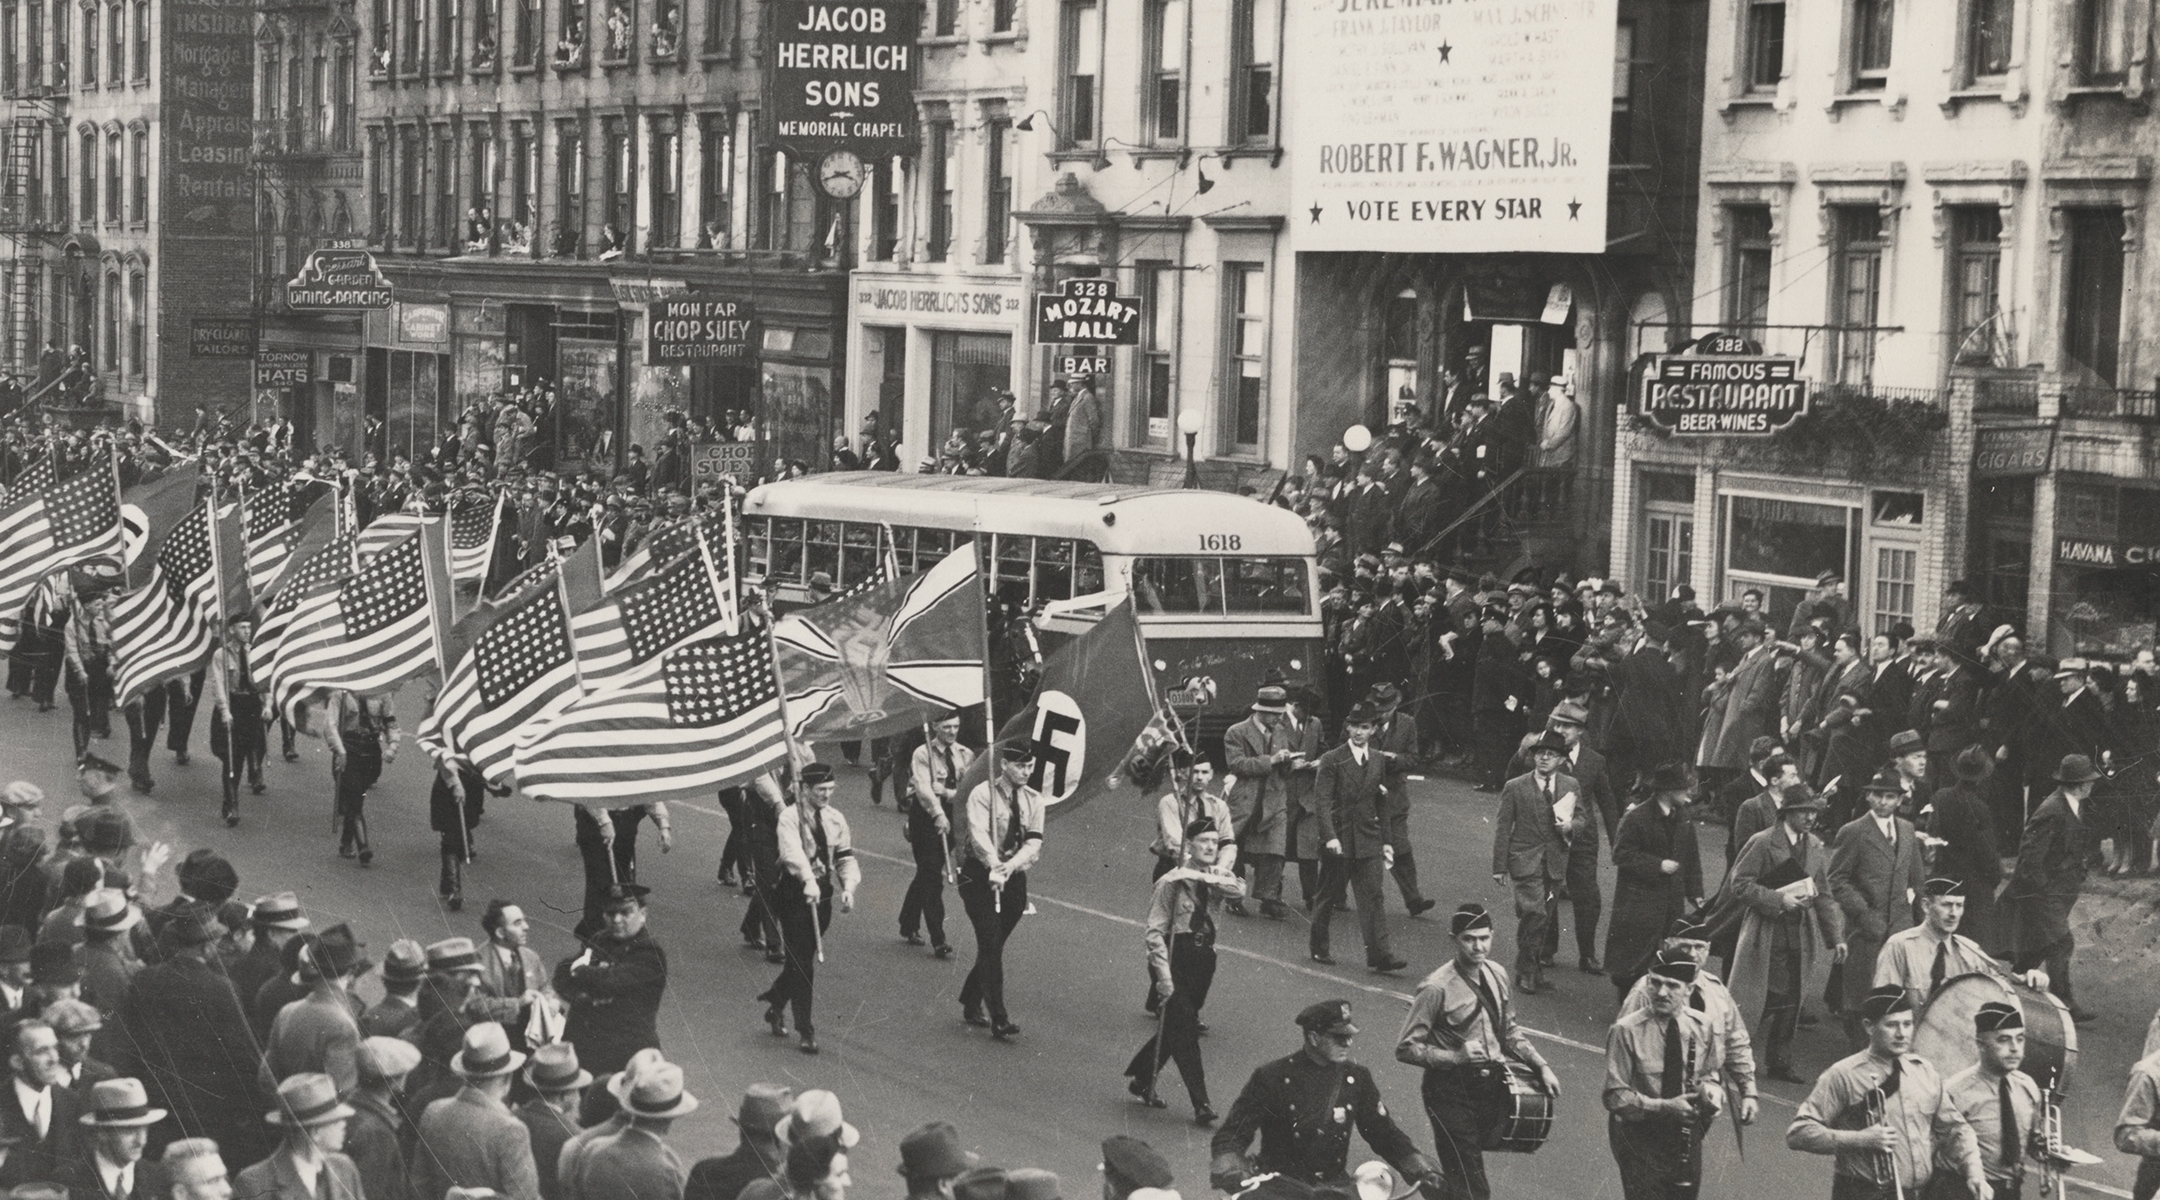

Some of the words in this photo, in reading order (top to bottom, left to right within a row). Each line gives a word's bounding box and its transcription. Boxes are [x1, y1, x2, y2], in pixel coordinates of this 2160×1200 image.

[176, 13, 253, 34] INSURA
[798, 5, 887, 33] JACOB
[778, 42, 908, 71] HERRLICH
[805, 80, 881, 108] SONS
[778, 121, 849, 137] MEMORIAL
[853, 121, 905, 138] CHAPEL
[1319, 142, 1409, 174] ROBERT
[1346, 199, 1400, 222] VOTE
[1411, 198, 1487, 222] EVERY
[1494, 197, 1543, 220] STAR
[327, 274, 373, 286] GARDEN
[1074, 283, 1108, 297] 328
[667, 302, 700, 317] MON
[874, 288, 908, 311] JACOB
[972, 292, 1003, 316] SONS
[1045, 297, 1138, 324] MOZART
[654, 320, 702, 342] CHOP
[705, 320, 751, 342] SUEY
[1063, 320, 1118, 340] HALL
[259, 352, 309, 362] TORNOW
[660, 344, 746, 358] RESTAURANT
[1064, 357, 1107, 374] BAR
[1690, 362, 1767, 381] FAMOUS
[257, 369, 308, 385] HATS
[1650, 382, 1801, 411] RESTAURANT
[1976, 450, 2047, 470] CIGARS
[1199, 533, 1242, 552] 1618
[2060, 540, 2114, 565] HAVANA
